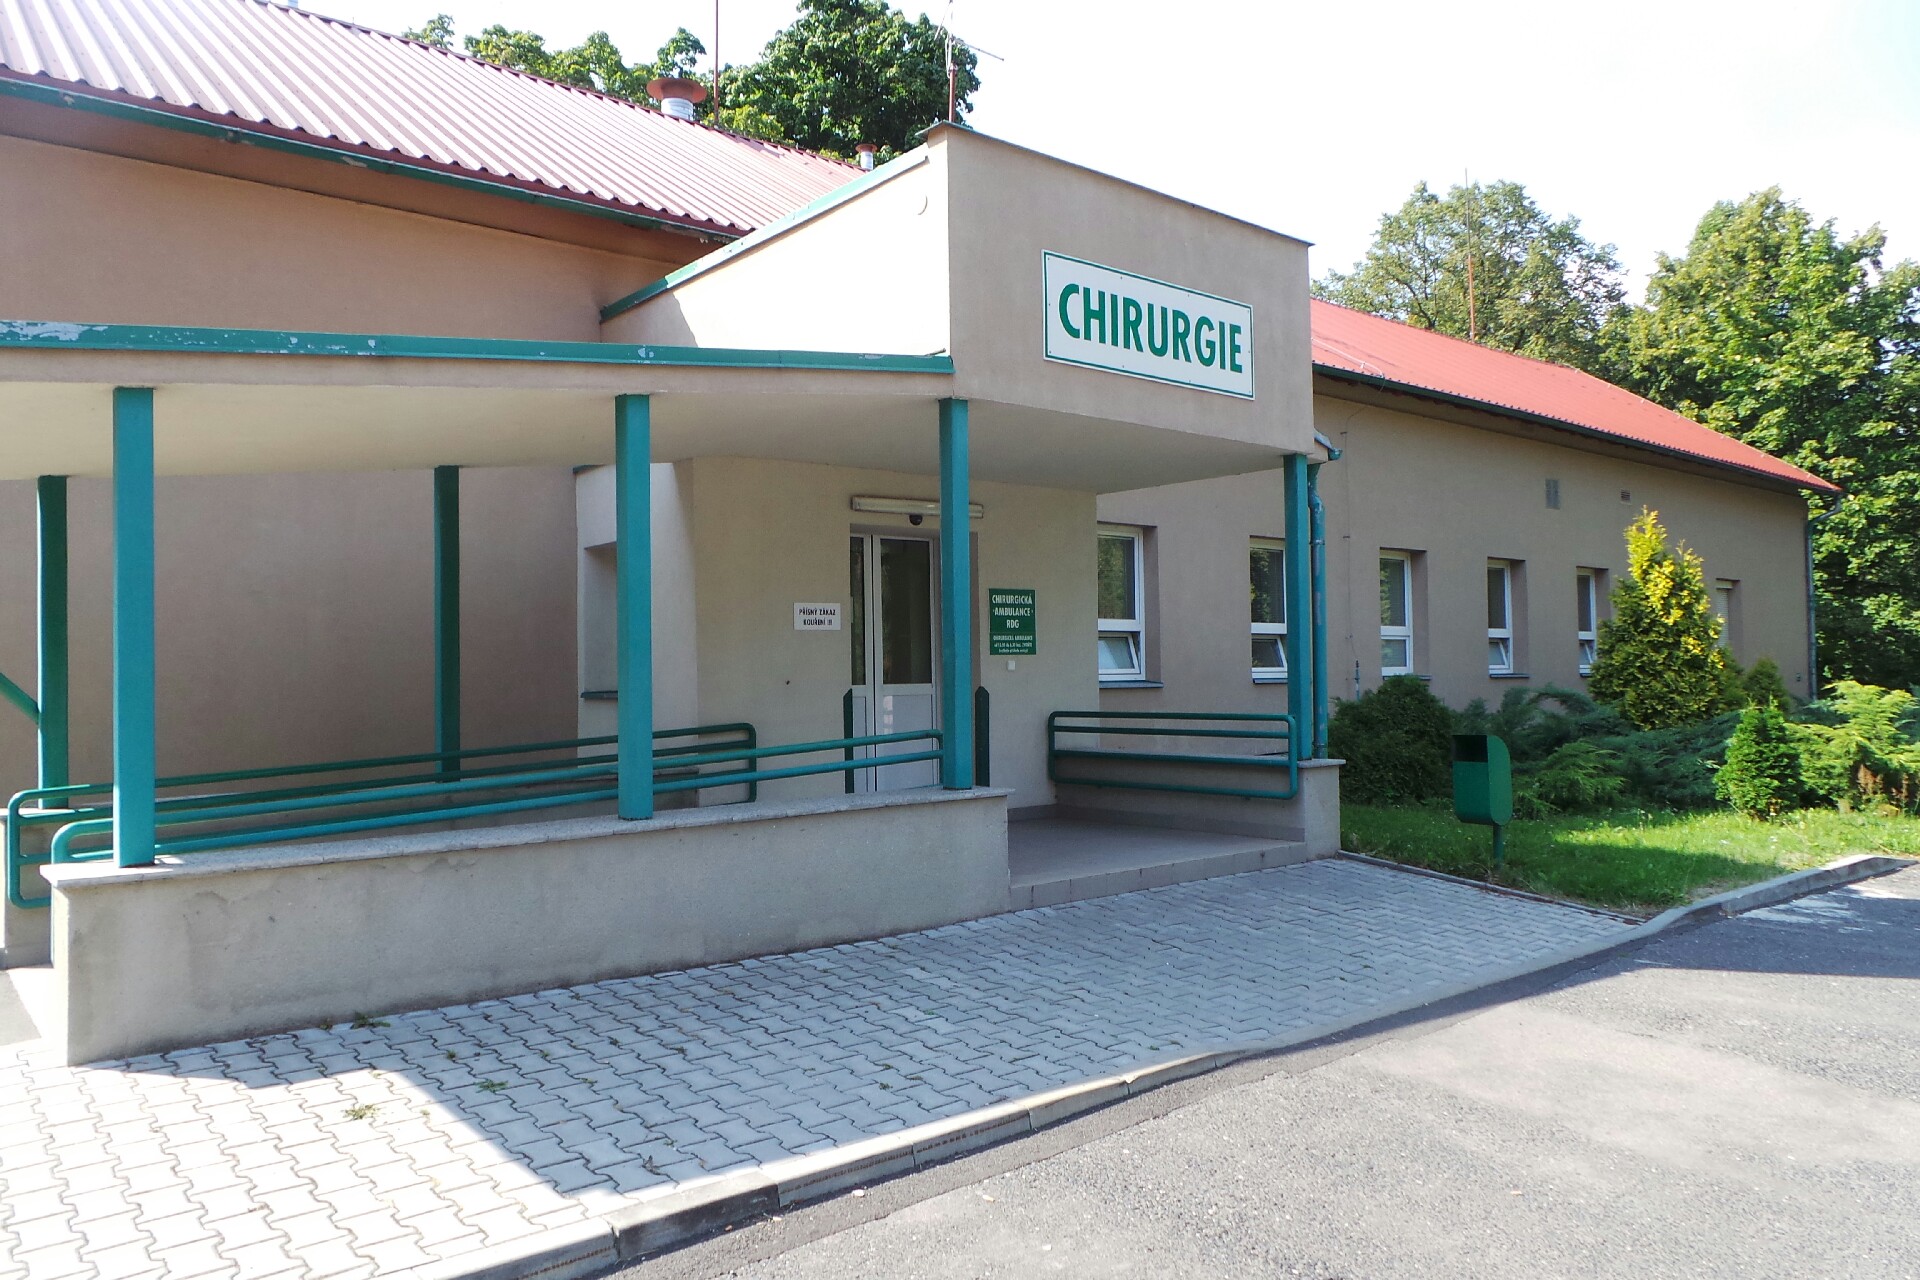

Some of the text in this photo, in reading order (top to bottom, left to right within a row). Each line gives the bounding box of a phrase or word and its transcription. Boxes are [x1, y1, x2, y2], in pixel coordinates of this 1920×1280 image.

[1058, 283, 1243, 374] CHIRURGIE
[991, 594, 1033, 605] CHIRURGICKÁ
[994, 607, 1031, 617] AMBULANCE
[1006, 619, 1020, 629] RDG
